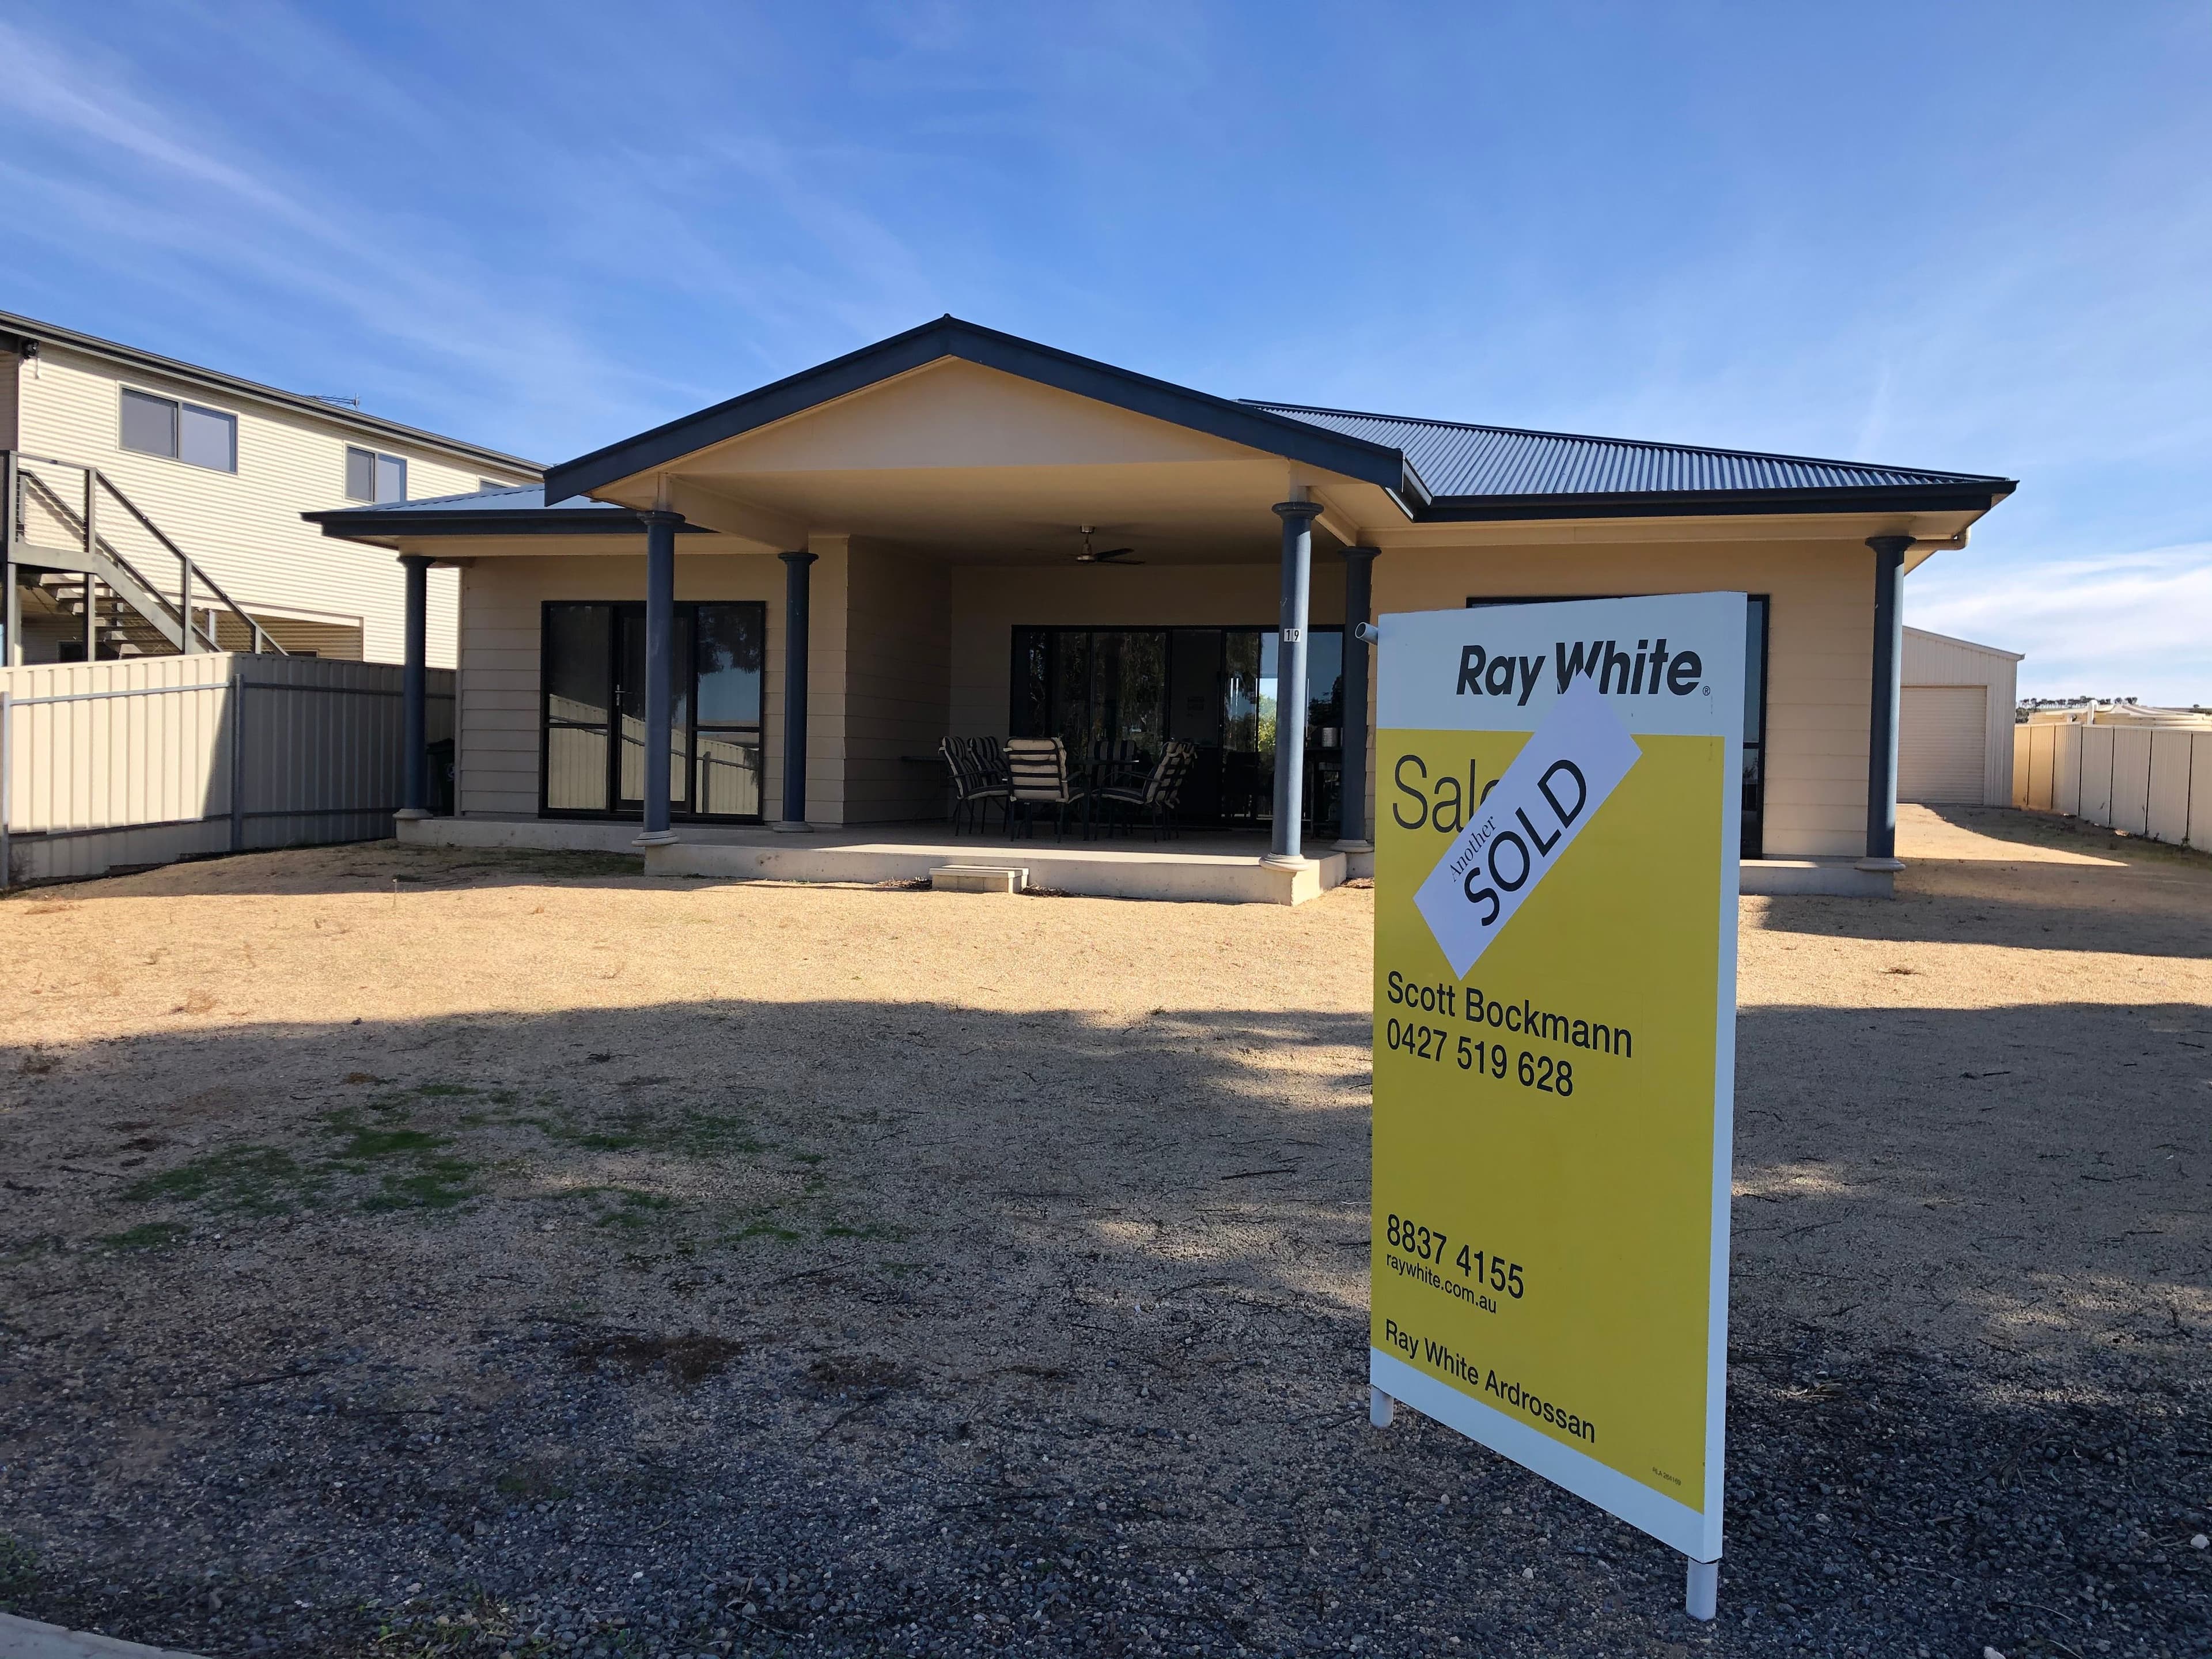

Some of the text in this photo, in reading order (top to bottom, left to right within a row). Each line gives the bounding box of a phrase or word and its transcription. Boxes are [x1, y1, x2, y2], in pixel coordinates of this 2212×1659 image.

[1286, 629, 1300, 641] 19
[1456, 638, 1702, 706] Ray White
[1392, 754, 1500, 834] Sal
[1449, 816, 1497, 882] Another
[1464, 759, 1586, 927] SOLD
[1387, 971, 1632, 1058] Scott Bockmann
[1387, 1018, 1574, 1097] 0427 519 628
[1386, 1252, 1497, 1315] raywhite.com.au
[1387, 1214, 1524, 1299] 8837 4155
[1385, 1318, 1596, 1444] Ray White Ardrossan
